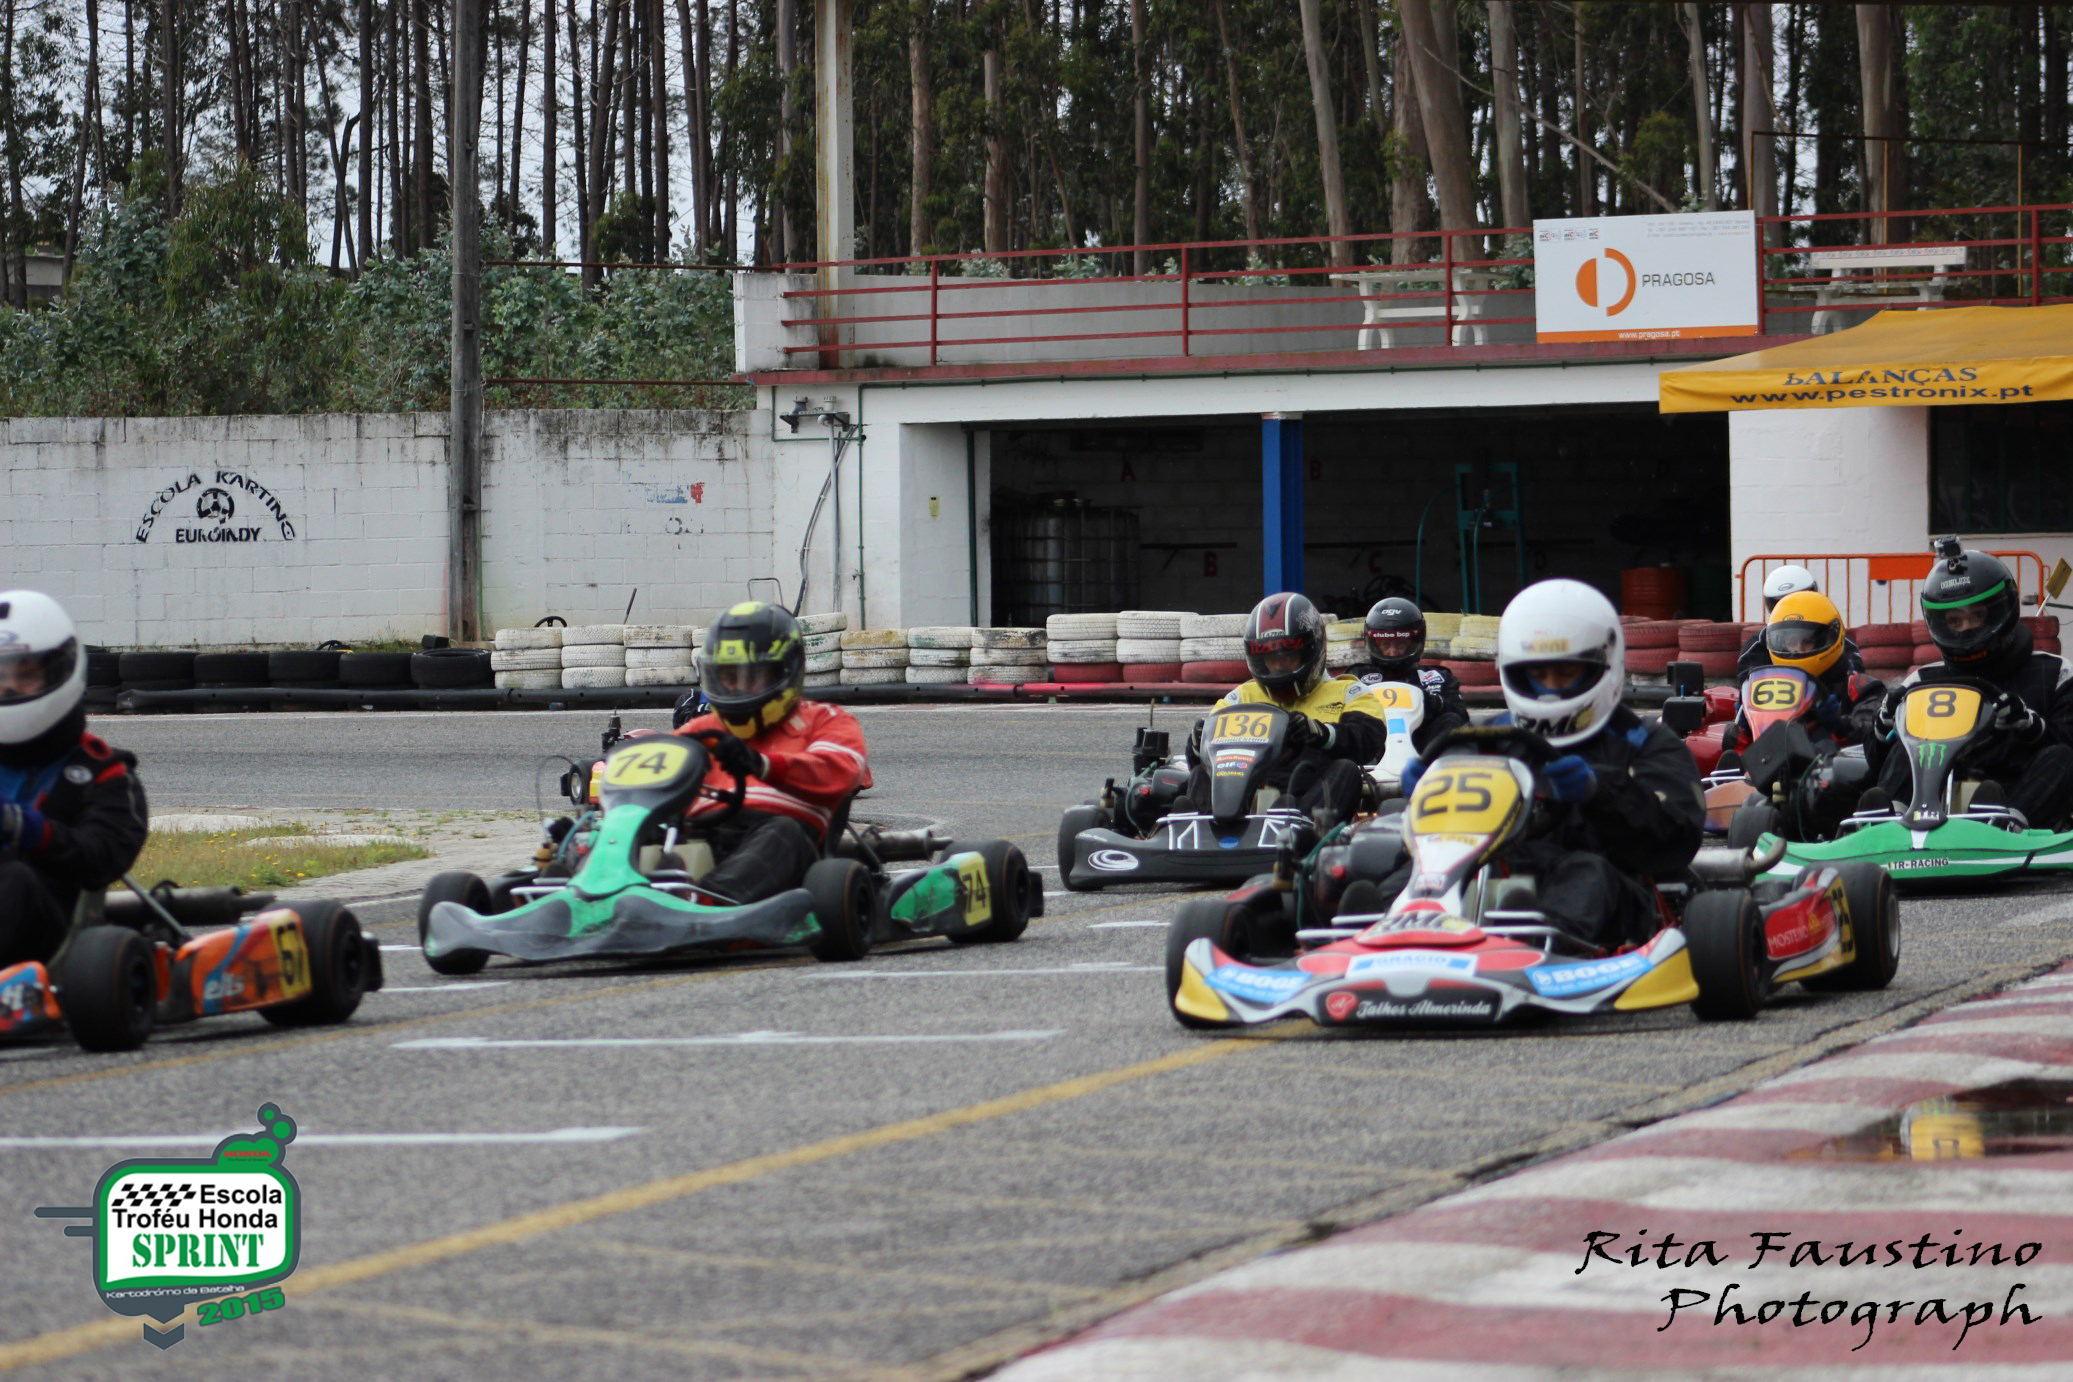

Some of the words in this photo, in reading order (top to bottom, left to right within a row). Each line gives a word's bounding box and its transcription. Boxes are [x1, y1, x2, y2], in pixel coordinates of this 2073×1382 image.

[1642, 272, 1715, 287] PRAGOSA
[1618, 331, 1681, 339] www.pragosa.pt
[1730, 384, 2034, 403] www.pestronix.pt
[136, 473, 202, 543] ESCOLA
[216, 470, 295, 541] KARTING
[1203, 551, 1218, 577] B
[1382, 688, 1398, 707] 9
[1753, 680, 1796, 705] 63
[1927, 690, 1956, 717] 8
[1217, 714, 1268, 737] 136
[615, 753, 666, 777] 74
[1418, 773, 1492, 819] 25
[961, 870, 987, 913] 74
[1552, 956, 1641, 982] BOGE
[1408, 1000, 1491, 1015] Almerinda
